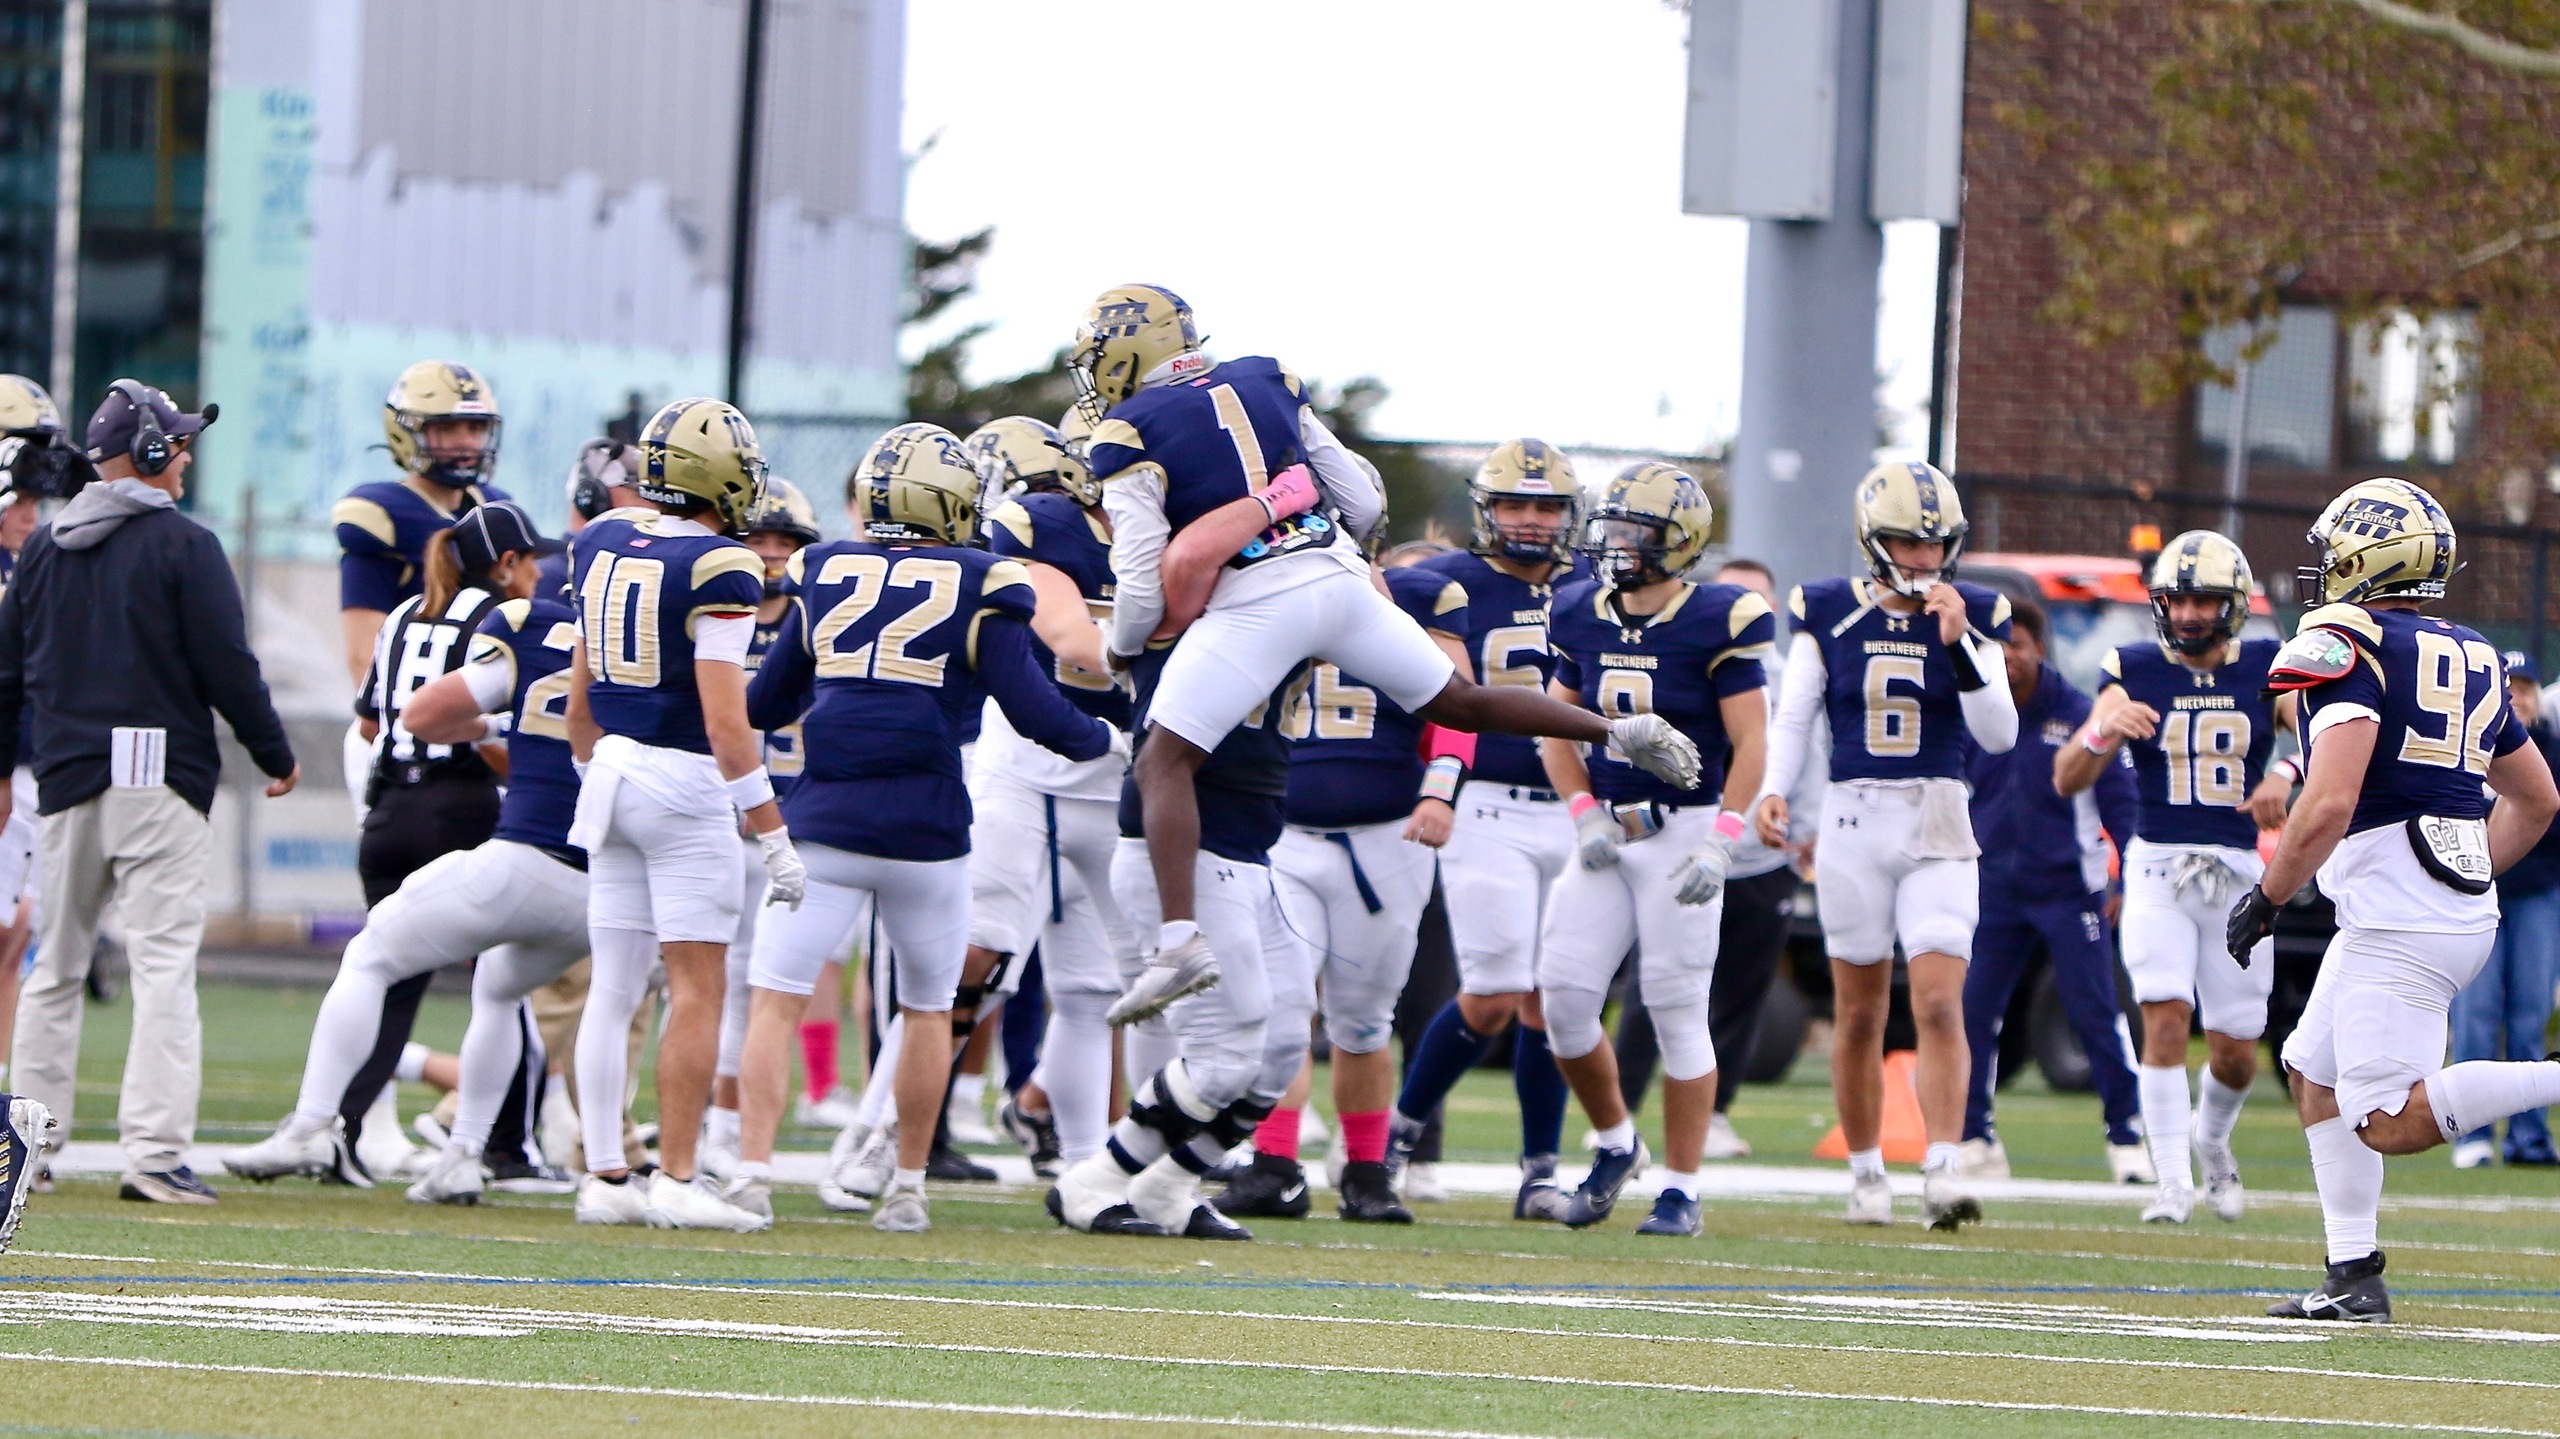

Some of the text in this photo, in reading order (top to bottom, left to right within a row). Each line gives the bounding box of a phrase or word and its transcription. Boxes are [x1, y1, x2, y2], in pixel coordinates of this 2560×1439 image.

[1207, 383, 1268, 497] 1
[391, 622, 461, 710] H
[580, 549, 665, 688] 10
[812, 554, 962, 687] 22
[1600, 652, 1658, 670] BUCCANEERS
[1863, 641, 1928, 657] BUCCANEERS
[1863, 655, 1926, 758] 6
[2173, 696, 2235, 710] BUCCANEERS
[2397, 630, 2502, 778] 92
[2158, 711, 2251, 807] 18
[2426, 820, 2461, 853] 92
